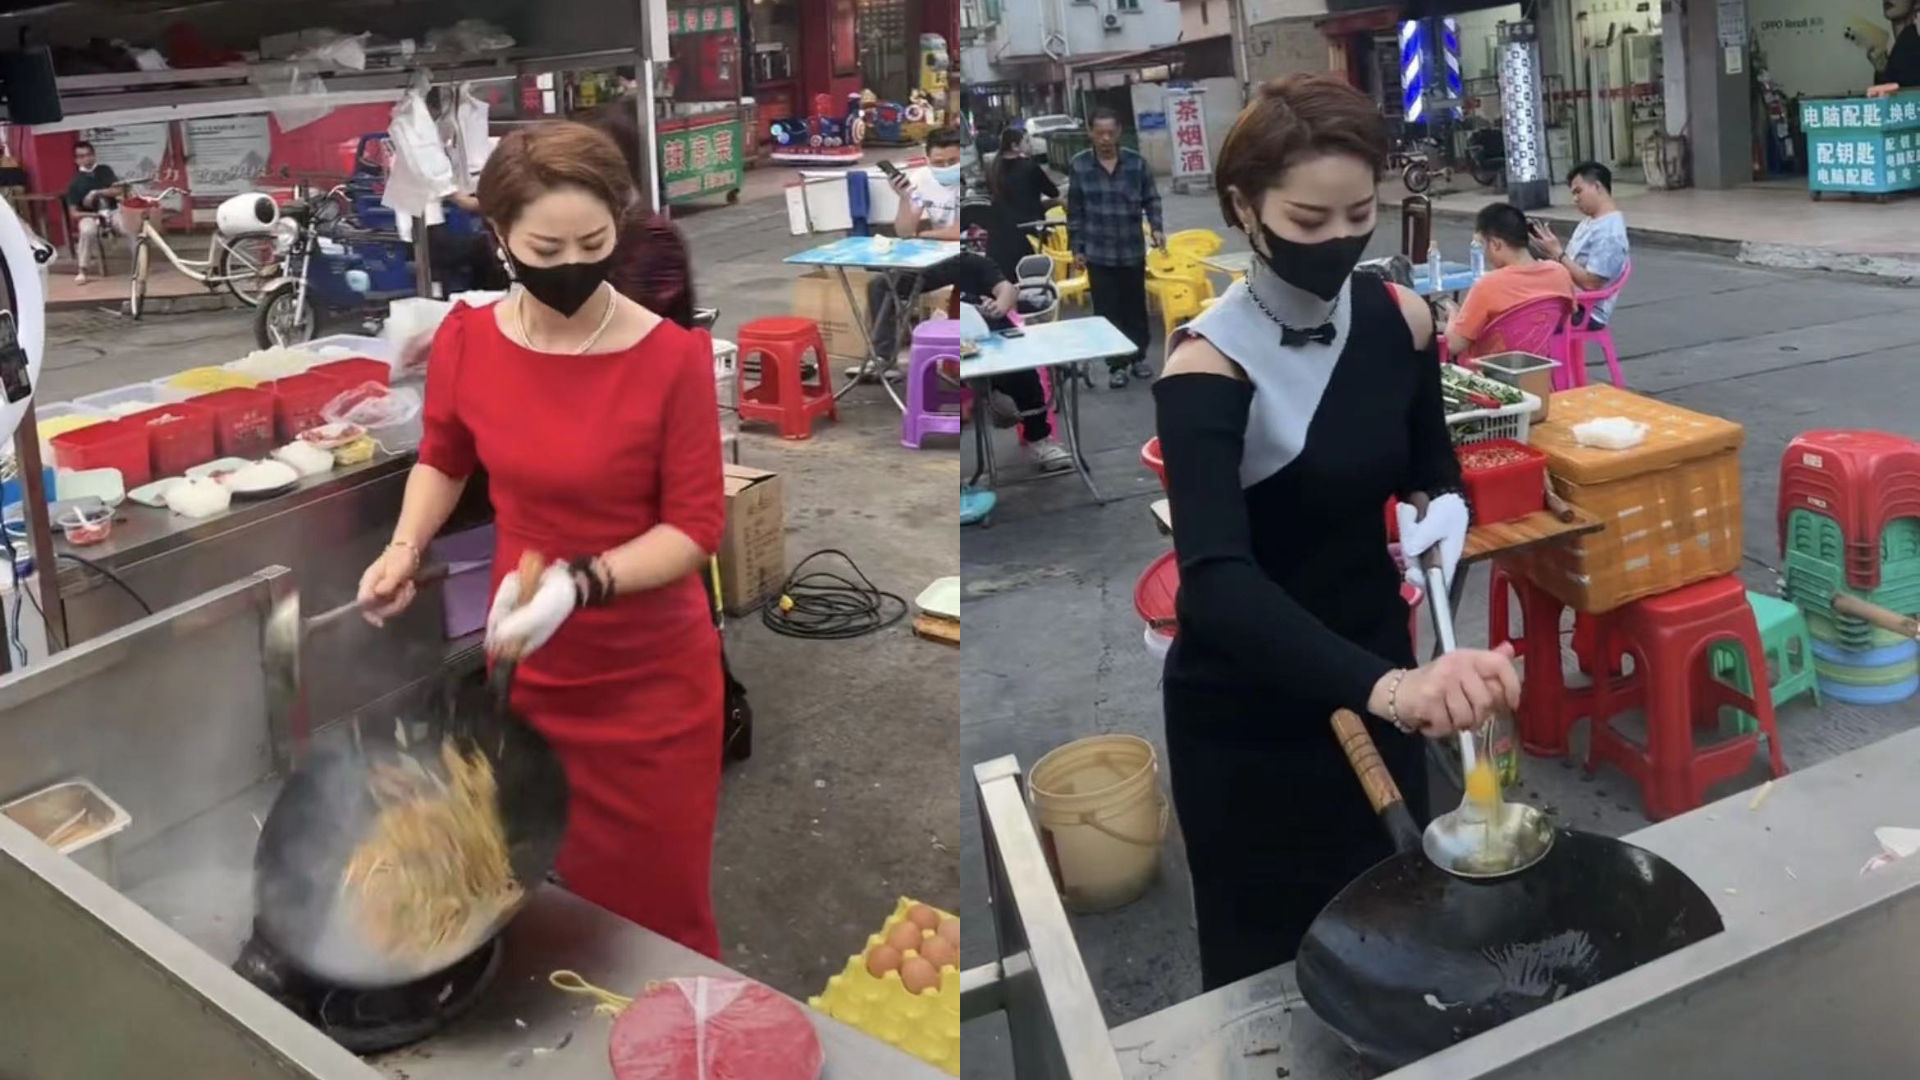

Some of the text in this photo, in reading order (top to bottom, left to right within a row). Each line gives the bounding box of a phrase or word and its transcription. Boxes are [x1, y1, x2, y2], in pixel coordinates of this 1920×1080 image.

[1803, 103, 1881, 128] 电脑配匙
[1889, 101, 1920, 123] 换电
[1174, 98, 1205, 172] 茶烟酒
[1816, 142, 1876, 165] 配钥匙
[1817, 167, 1876, 186] 电脑配匙
